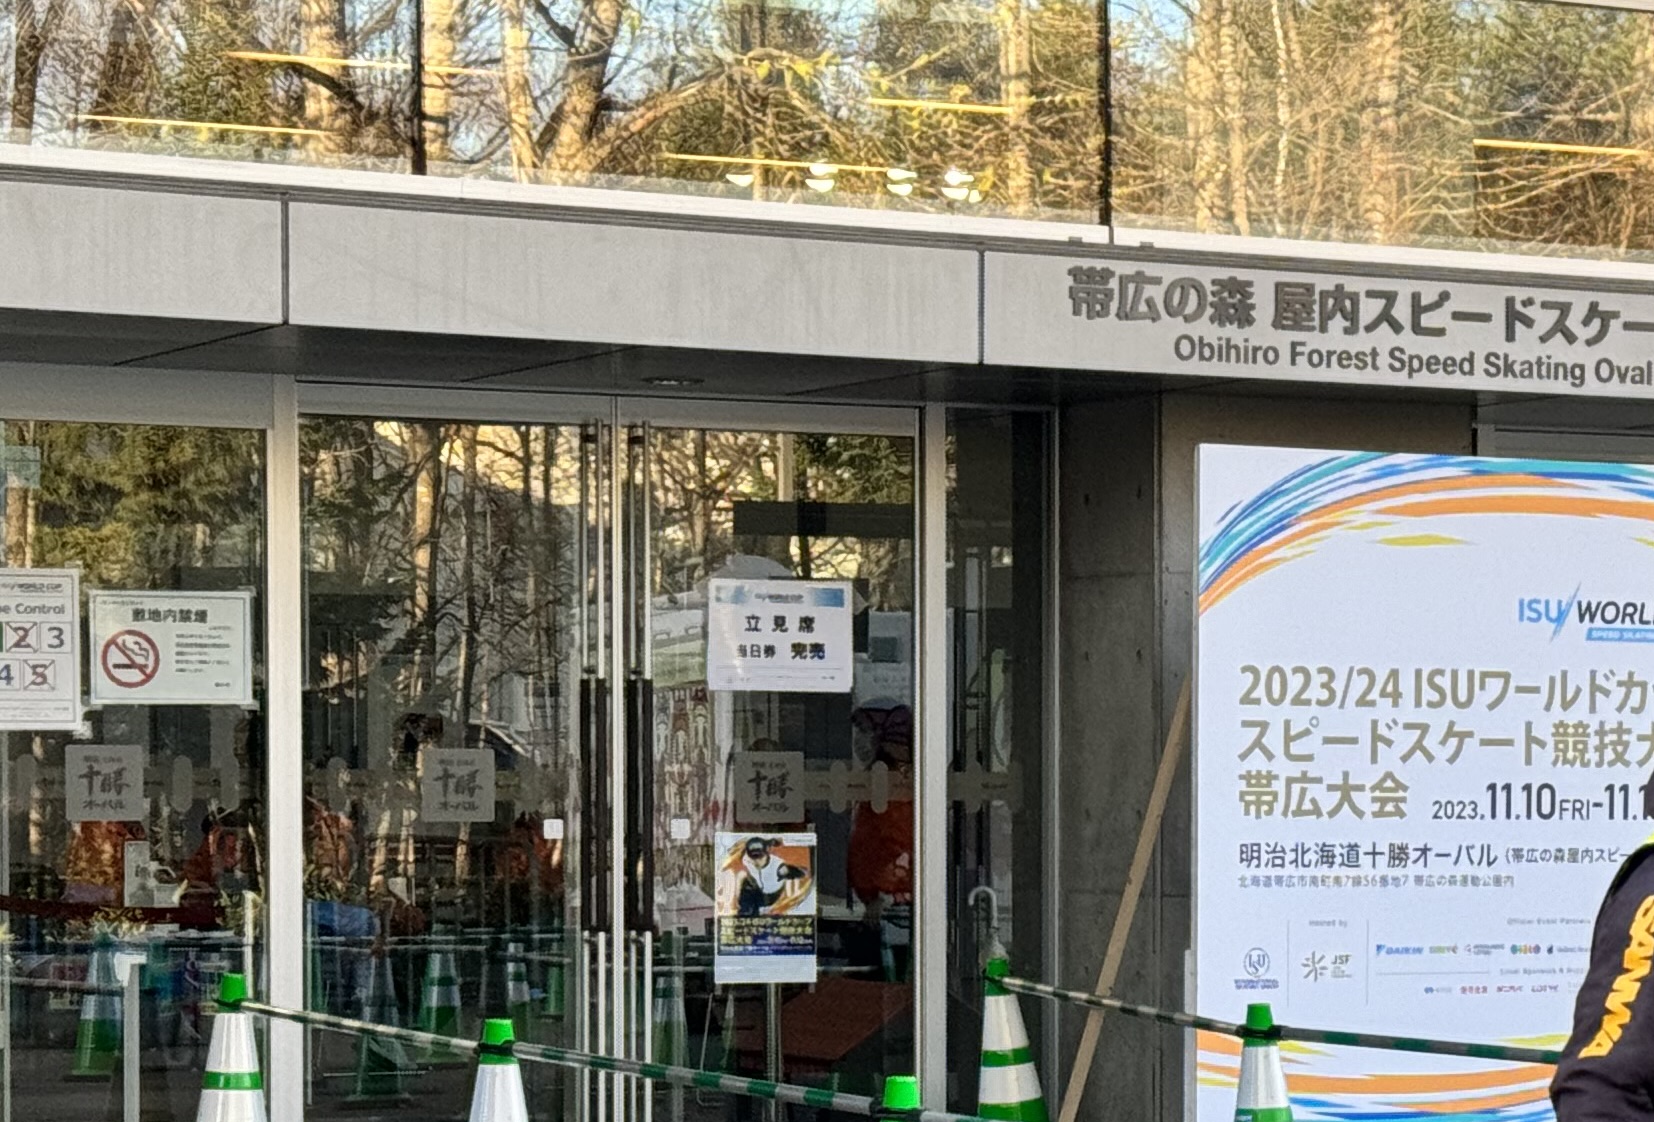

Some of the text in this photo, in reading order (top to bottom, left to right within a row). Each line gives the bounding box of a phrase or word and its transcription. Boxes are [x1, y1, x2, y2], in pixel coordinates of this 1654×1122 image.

[1066, 264, 1257, 330] 帯広の森
[1173, 333, 1654, 388] Obihiro Forest Speed Skating Oval
[15, 602, 66, 615] Control
[1517, 598, 1565, 623] ISU
[17, 627, 65, 649] 2 3
[0, 664, 15, 685] 4
[1238, 664, 1404, 710] 2023/24
[1238, 769, 1411, 820] 帯広大会
[1238, 841, 1499, 870] 明治北海道十勝オーバル
